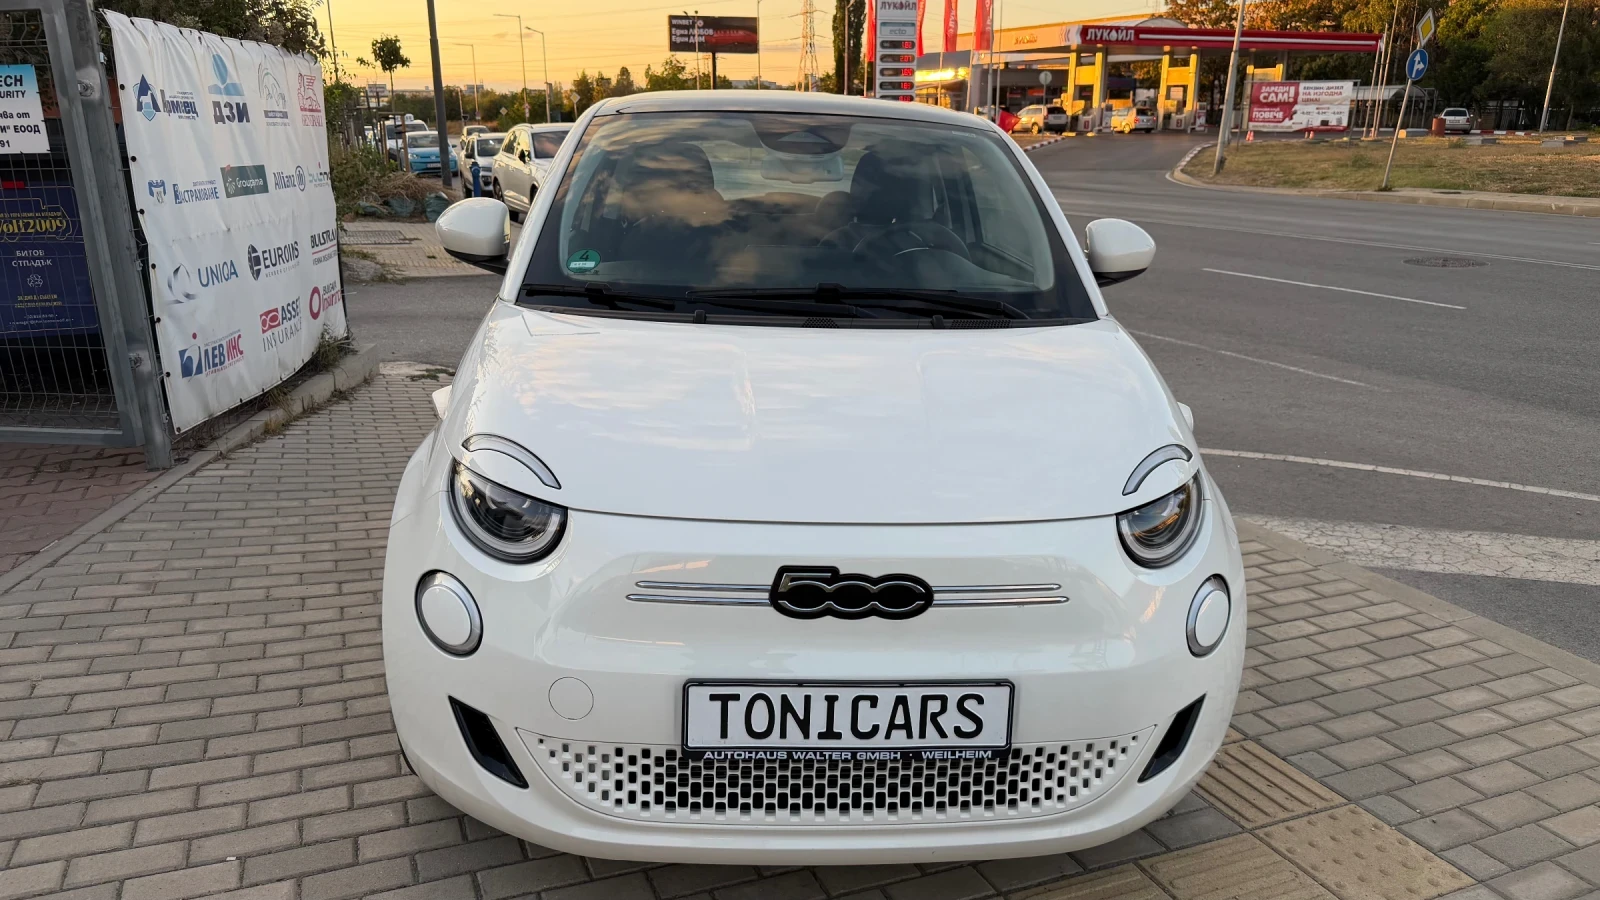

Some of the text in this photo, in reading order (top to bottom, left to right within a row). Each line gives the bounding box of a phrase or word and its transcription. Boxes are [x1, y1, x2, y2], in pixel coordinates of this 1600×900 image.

[1086, 27, 1135, 41] ЛУКОЙЛ
[212, 101, 250, 124] ДЗИ
[14, 124, 41, 134] ЕООД
[235, 177, 264, 188] Groupama
[273, 171, 297, 190] Allianz
[16, 249, 45, 257] БИТОВ
[579, 250, 590, 261] 4
[198, 260, 239, 288] UNIQA
[204, 343, 226, 373] ЛЕВ
[775, 570, 928, 616] 500
[709, 693, 984, 740] TONICARS
[703, 750, 992, 760] AUTOHAUS WALTER GMBH WEILHEIM
